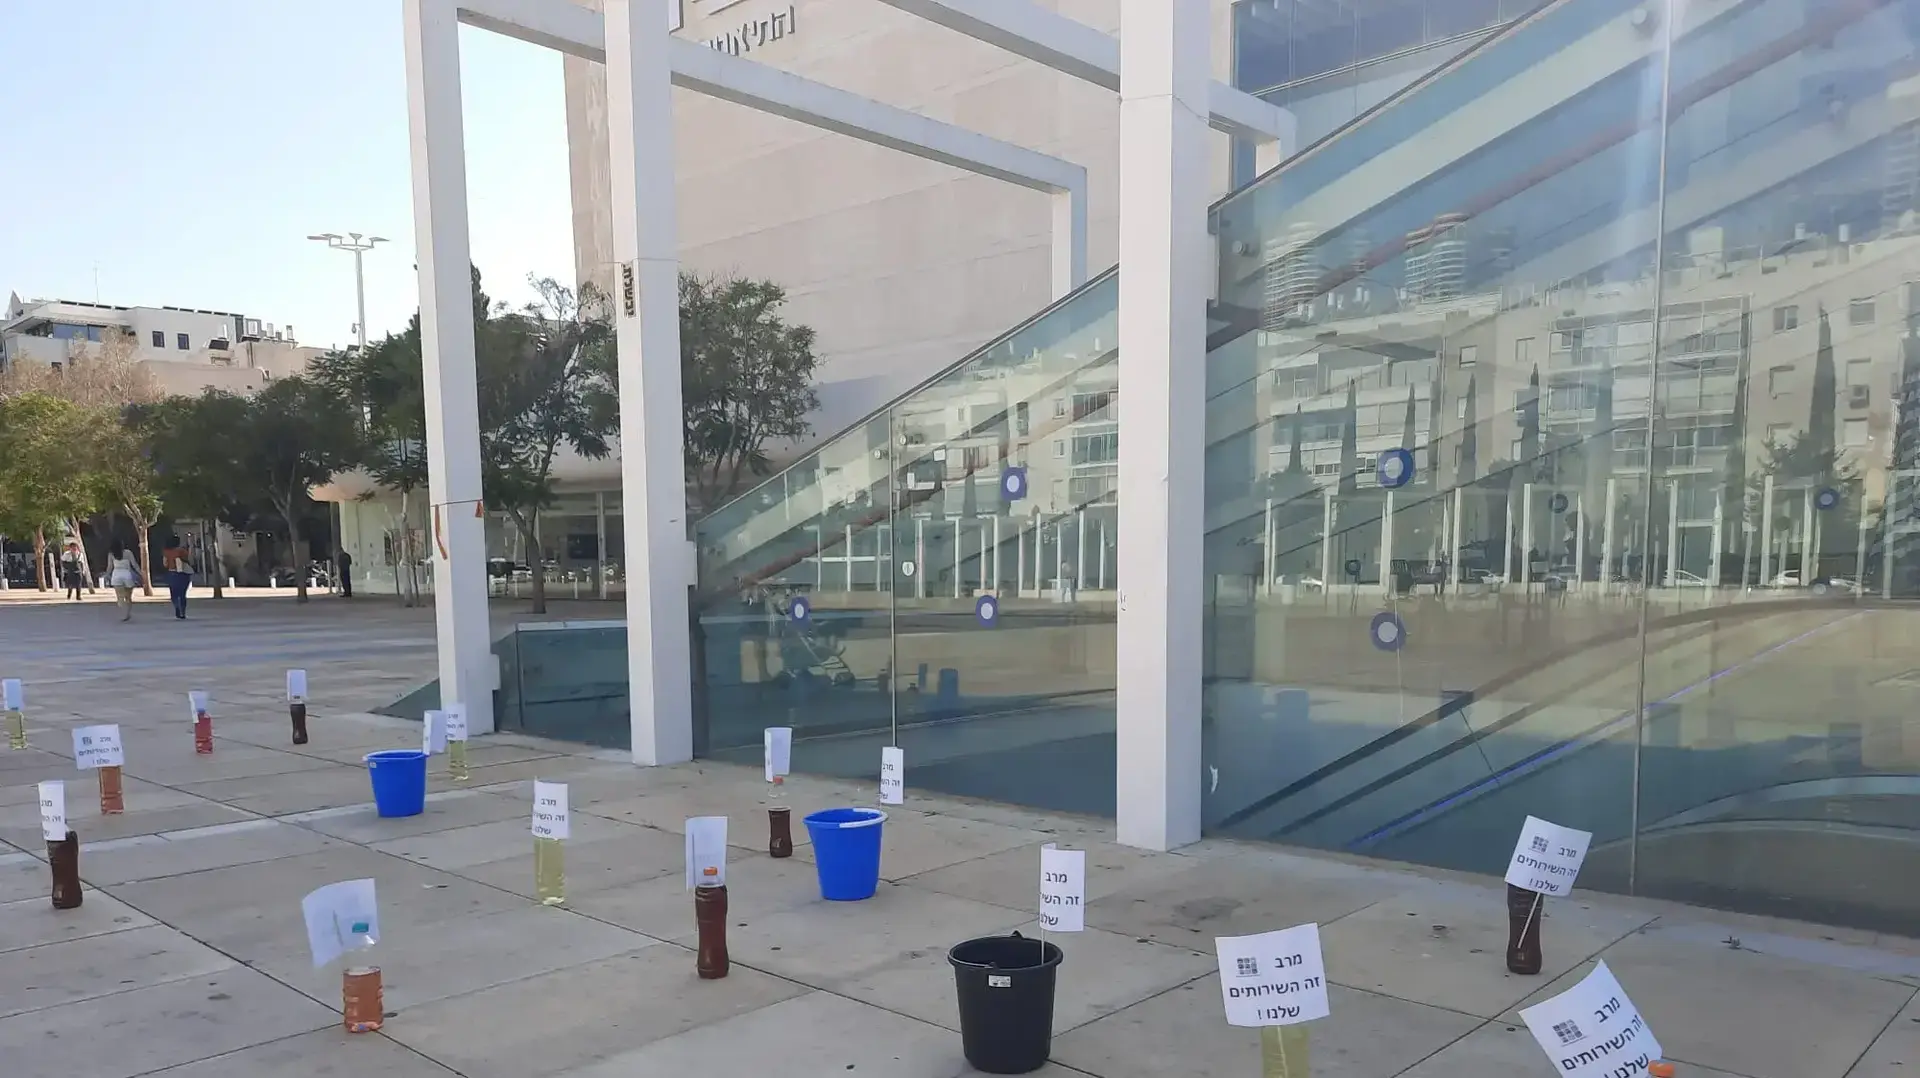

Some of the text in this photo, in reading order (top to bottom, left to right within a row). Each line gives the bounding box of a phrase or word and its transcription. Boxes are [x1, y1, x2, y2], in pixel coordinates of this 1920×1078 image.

[555, 814, 565, 822] זה
[1558, 846, 1577, 858] מרב
[1516, 854, 1577, 878] זה השירותים
[1045, 871, 1068, 883] מרב
[1535, 879, 1559, 892] שלנו
[1065, 895, 1080, 905] זה
[1274, 953, 1303, 969] מרב
[1229, 976, 1320, 998] זה השירותים
[1266, 1005, 1300, 1019] שלנו
[1594, 996, 1621, 1024] מרב
[1561, 1014, 1643, 1071] זה השירותים
[1614, 1052, 1649, 1078] שלנו
